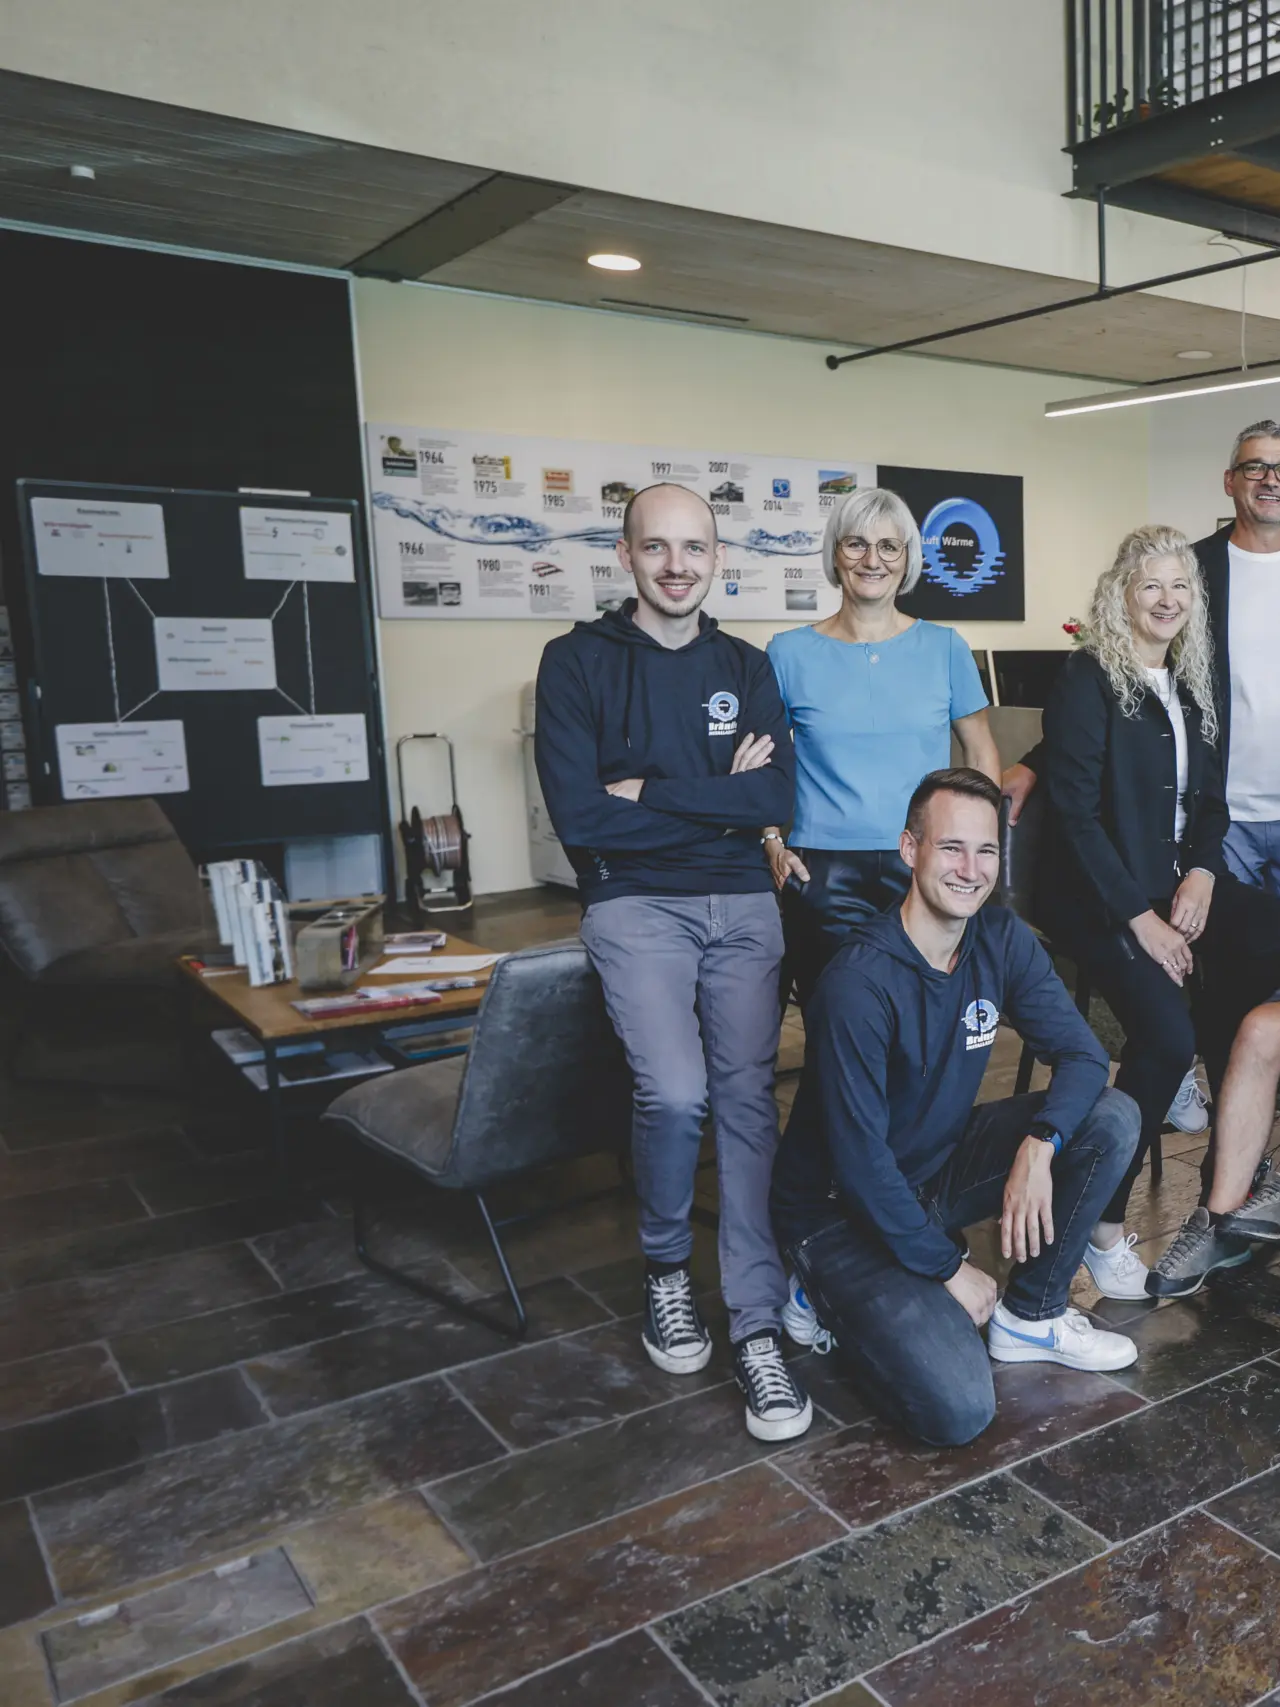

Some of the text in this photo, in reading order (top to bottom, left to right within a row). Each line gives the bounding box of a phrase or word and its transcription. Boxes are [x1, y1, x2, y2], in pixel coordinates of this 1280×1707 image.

[419, 450, 444, 464] 1964
[651, 462, 671, 475] 1997
[709, 461, 729, 473] 2007
[474, 480, 497, 493] 1975
[543, 494, 565, 507] 1985
[764, 500, 783, 511] 2014
[819, 496, 836, 507] 2021
[602, 506, 623, 519] 1992
[942, 536, 974, 547] Wärme
[399, 542, 424, 555] 1966
[477, 559, 501, 571] 1980
[590, 566, 612, 578] 1990
[721, 569, 741, 580] 2010
[784, 568, 803, 579] 2020
[529, 584, 550, 596] 1981
